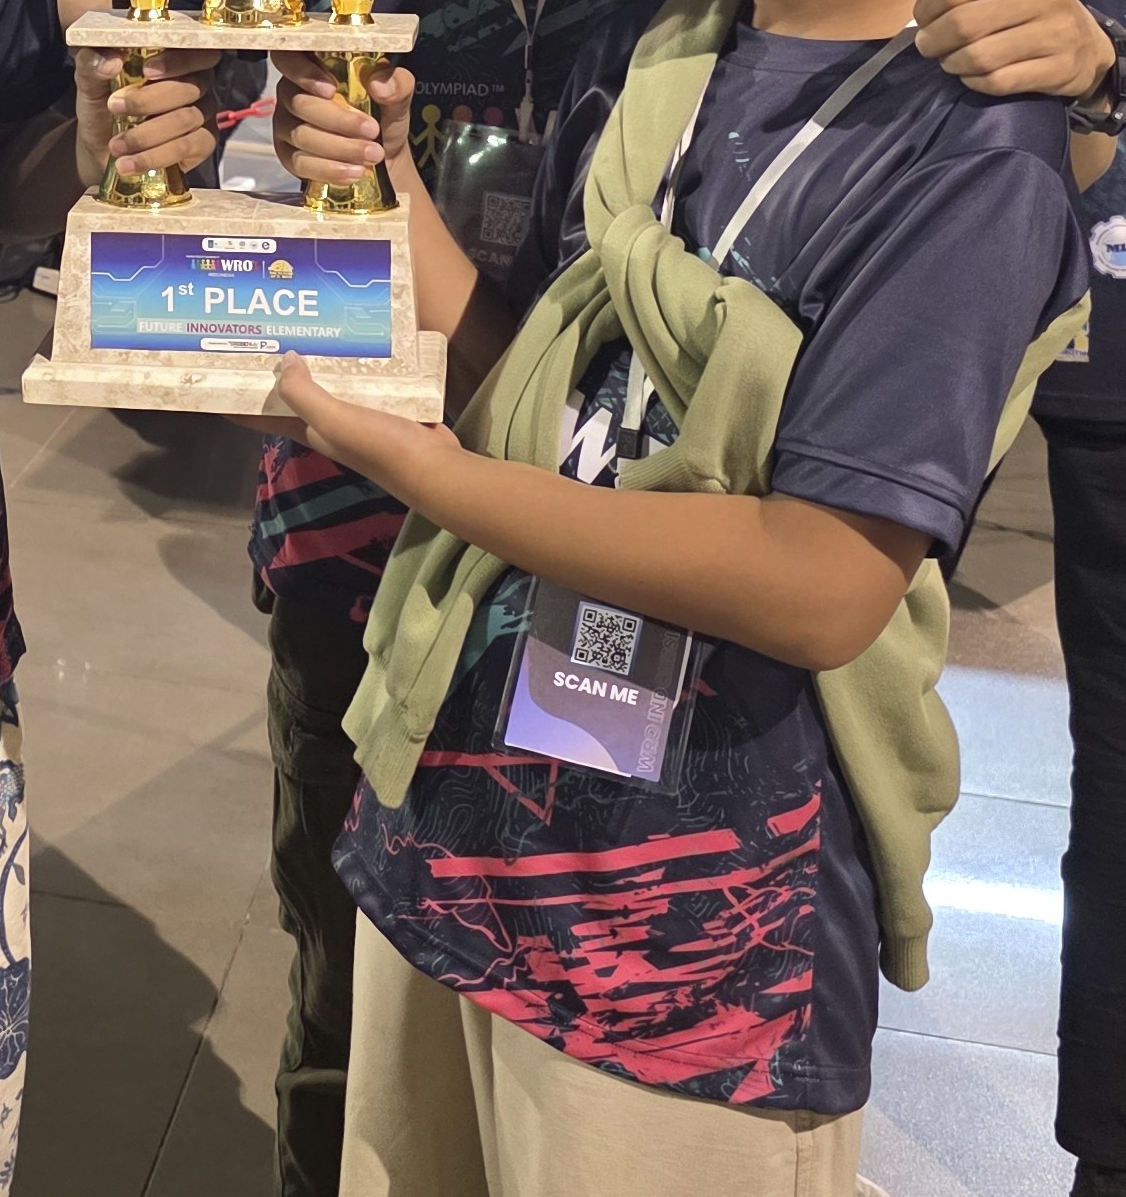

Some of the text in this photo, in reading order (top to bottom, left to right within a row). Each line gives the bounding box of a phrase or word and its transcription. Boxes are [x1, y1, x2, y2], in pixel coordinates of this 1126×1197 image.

[221, 259, 254, 272] WRO
[161, 282, 319, 317] 1st PLACE
[138, 321, 342, 338] FUTURE INNOVATORS ELEMENTARY
[553, 671, 640, 706] SCAN ME
[636, 722, 662, 773] WRO
